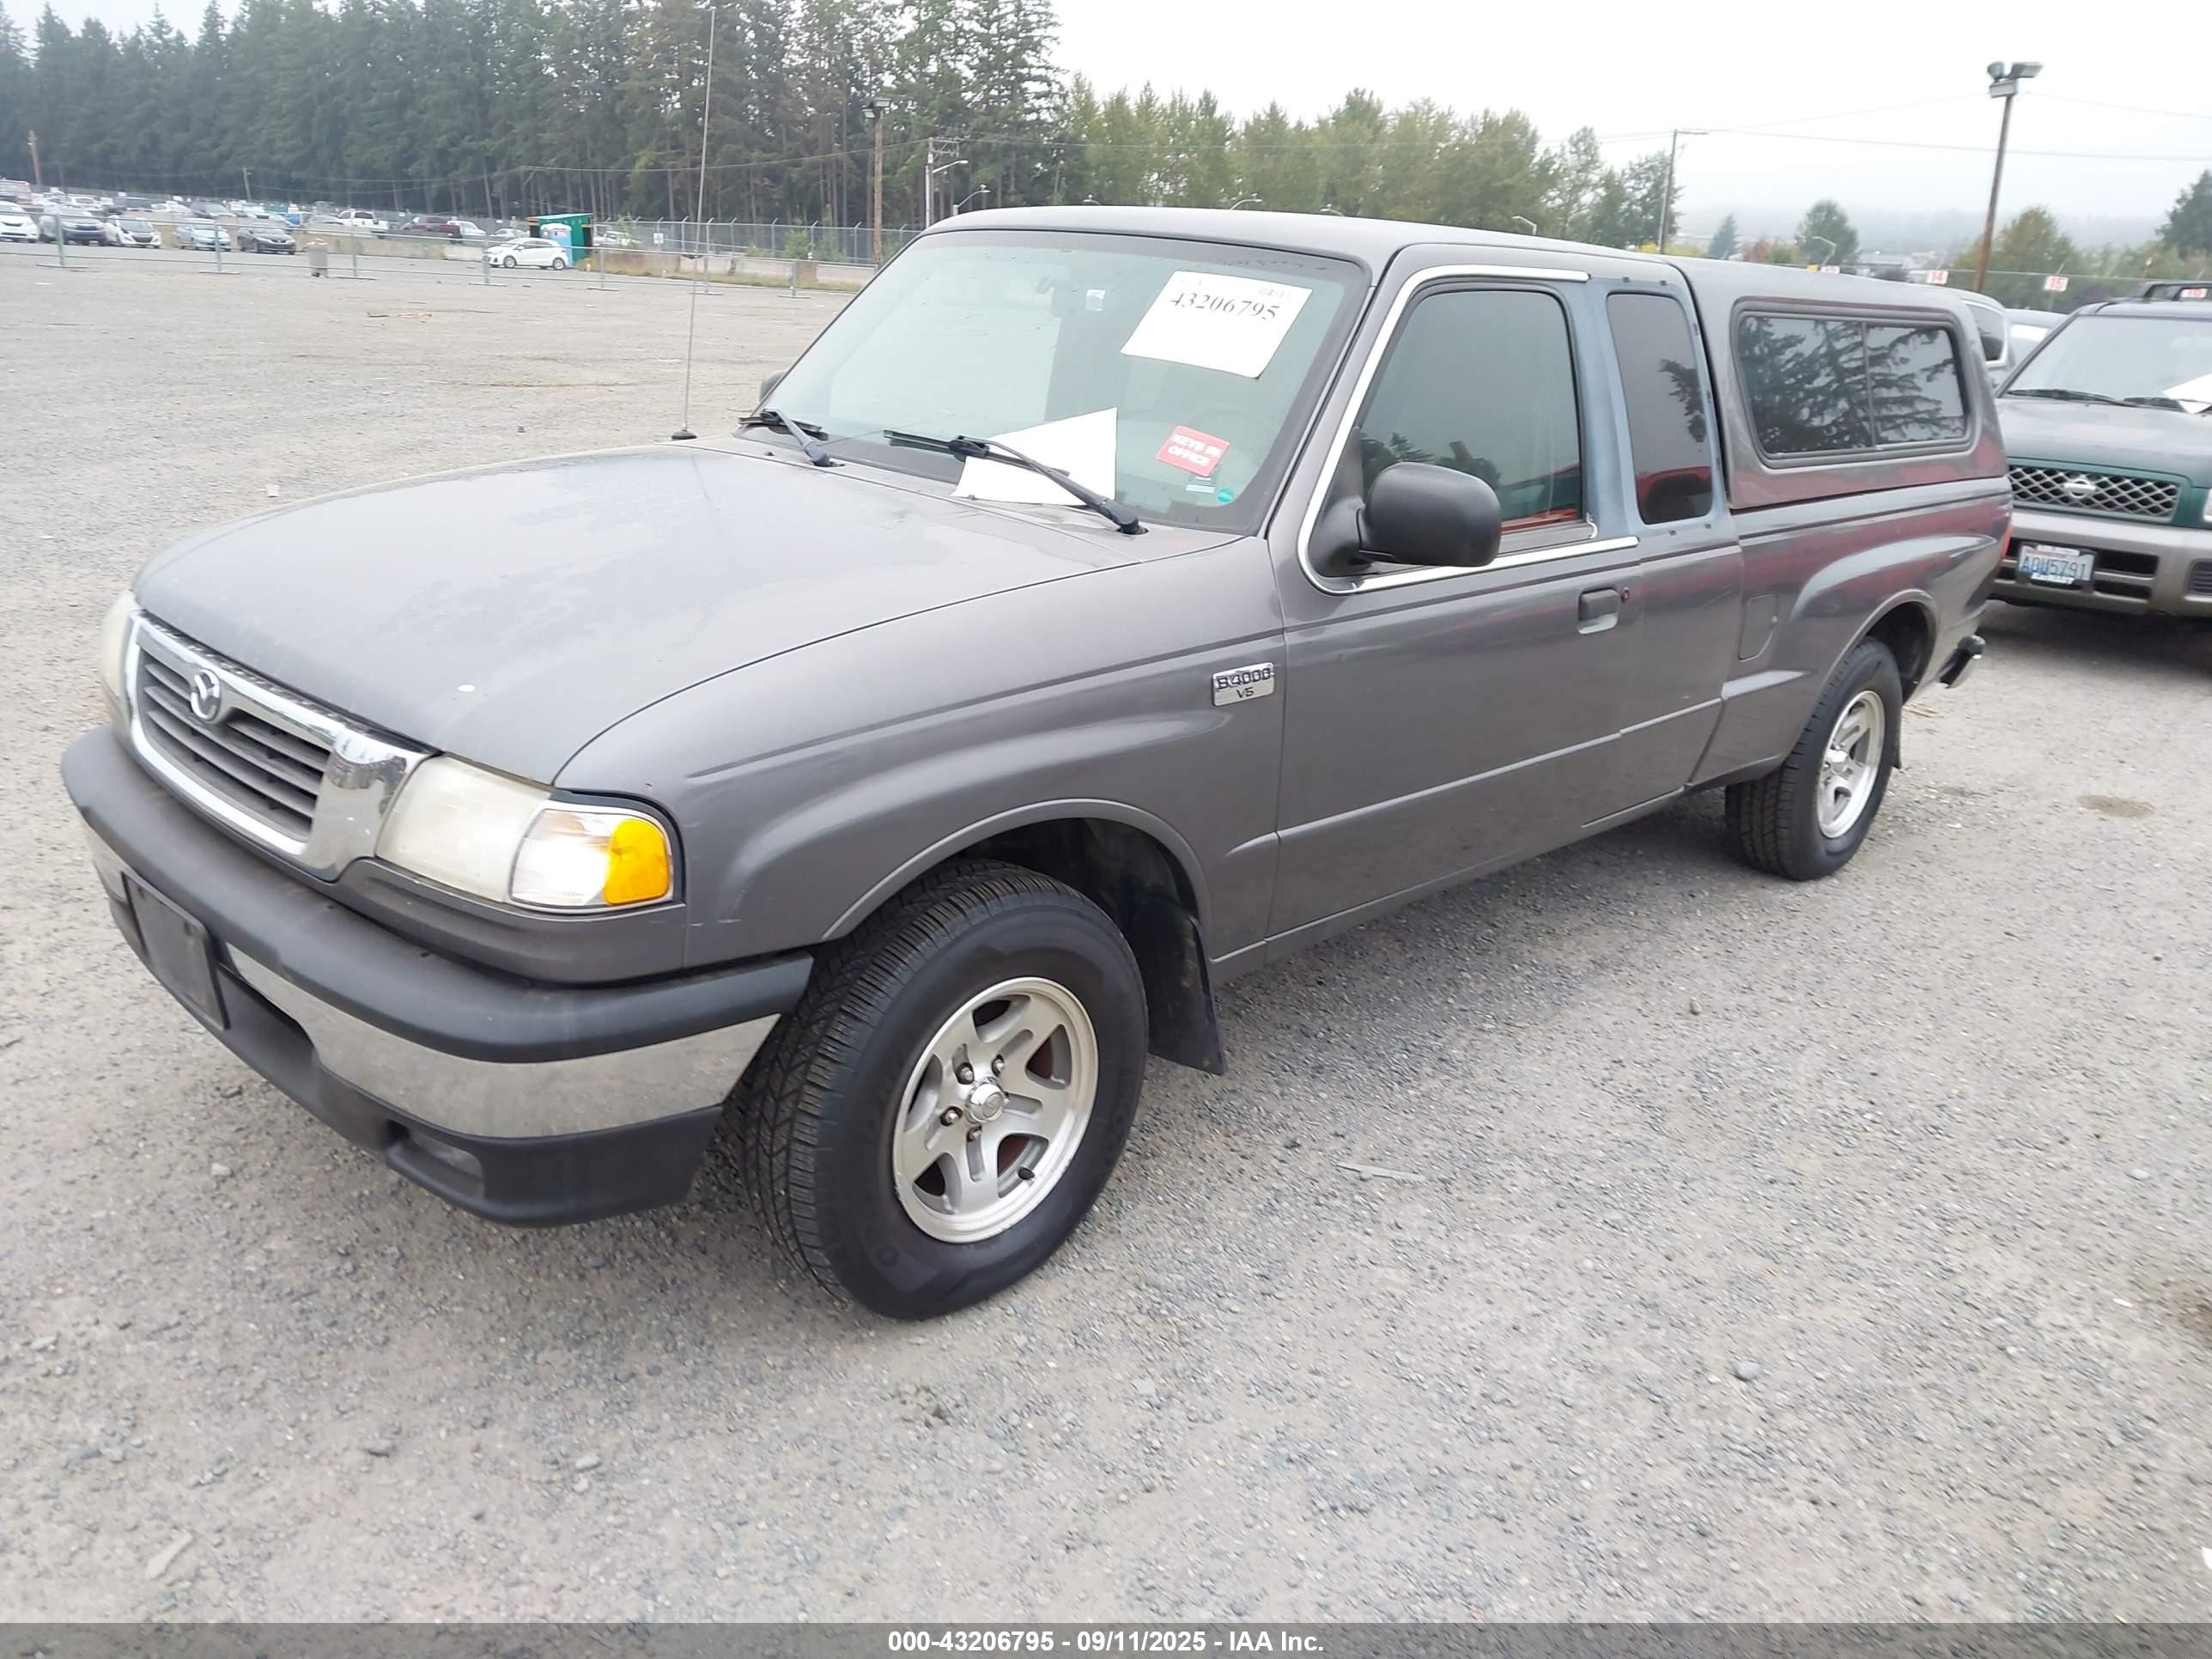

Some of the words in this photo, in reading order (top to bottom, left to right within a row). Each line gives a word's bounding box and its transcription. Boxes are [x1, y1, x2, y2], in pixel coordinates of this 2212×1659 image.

[1170, 292, 1280, 320] 43206795
[1170, 433, 1206, 451] KEYS
[1168, 445, 1212, 466] OFFICE
[1216, 667, 1271, 690] B4000
